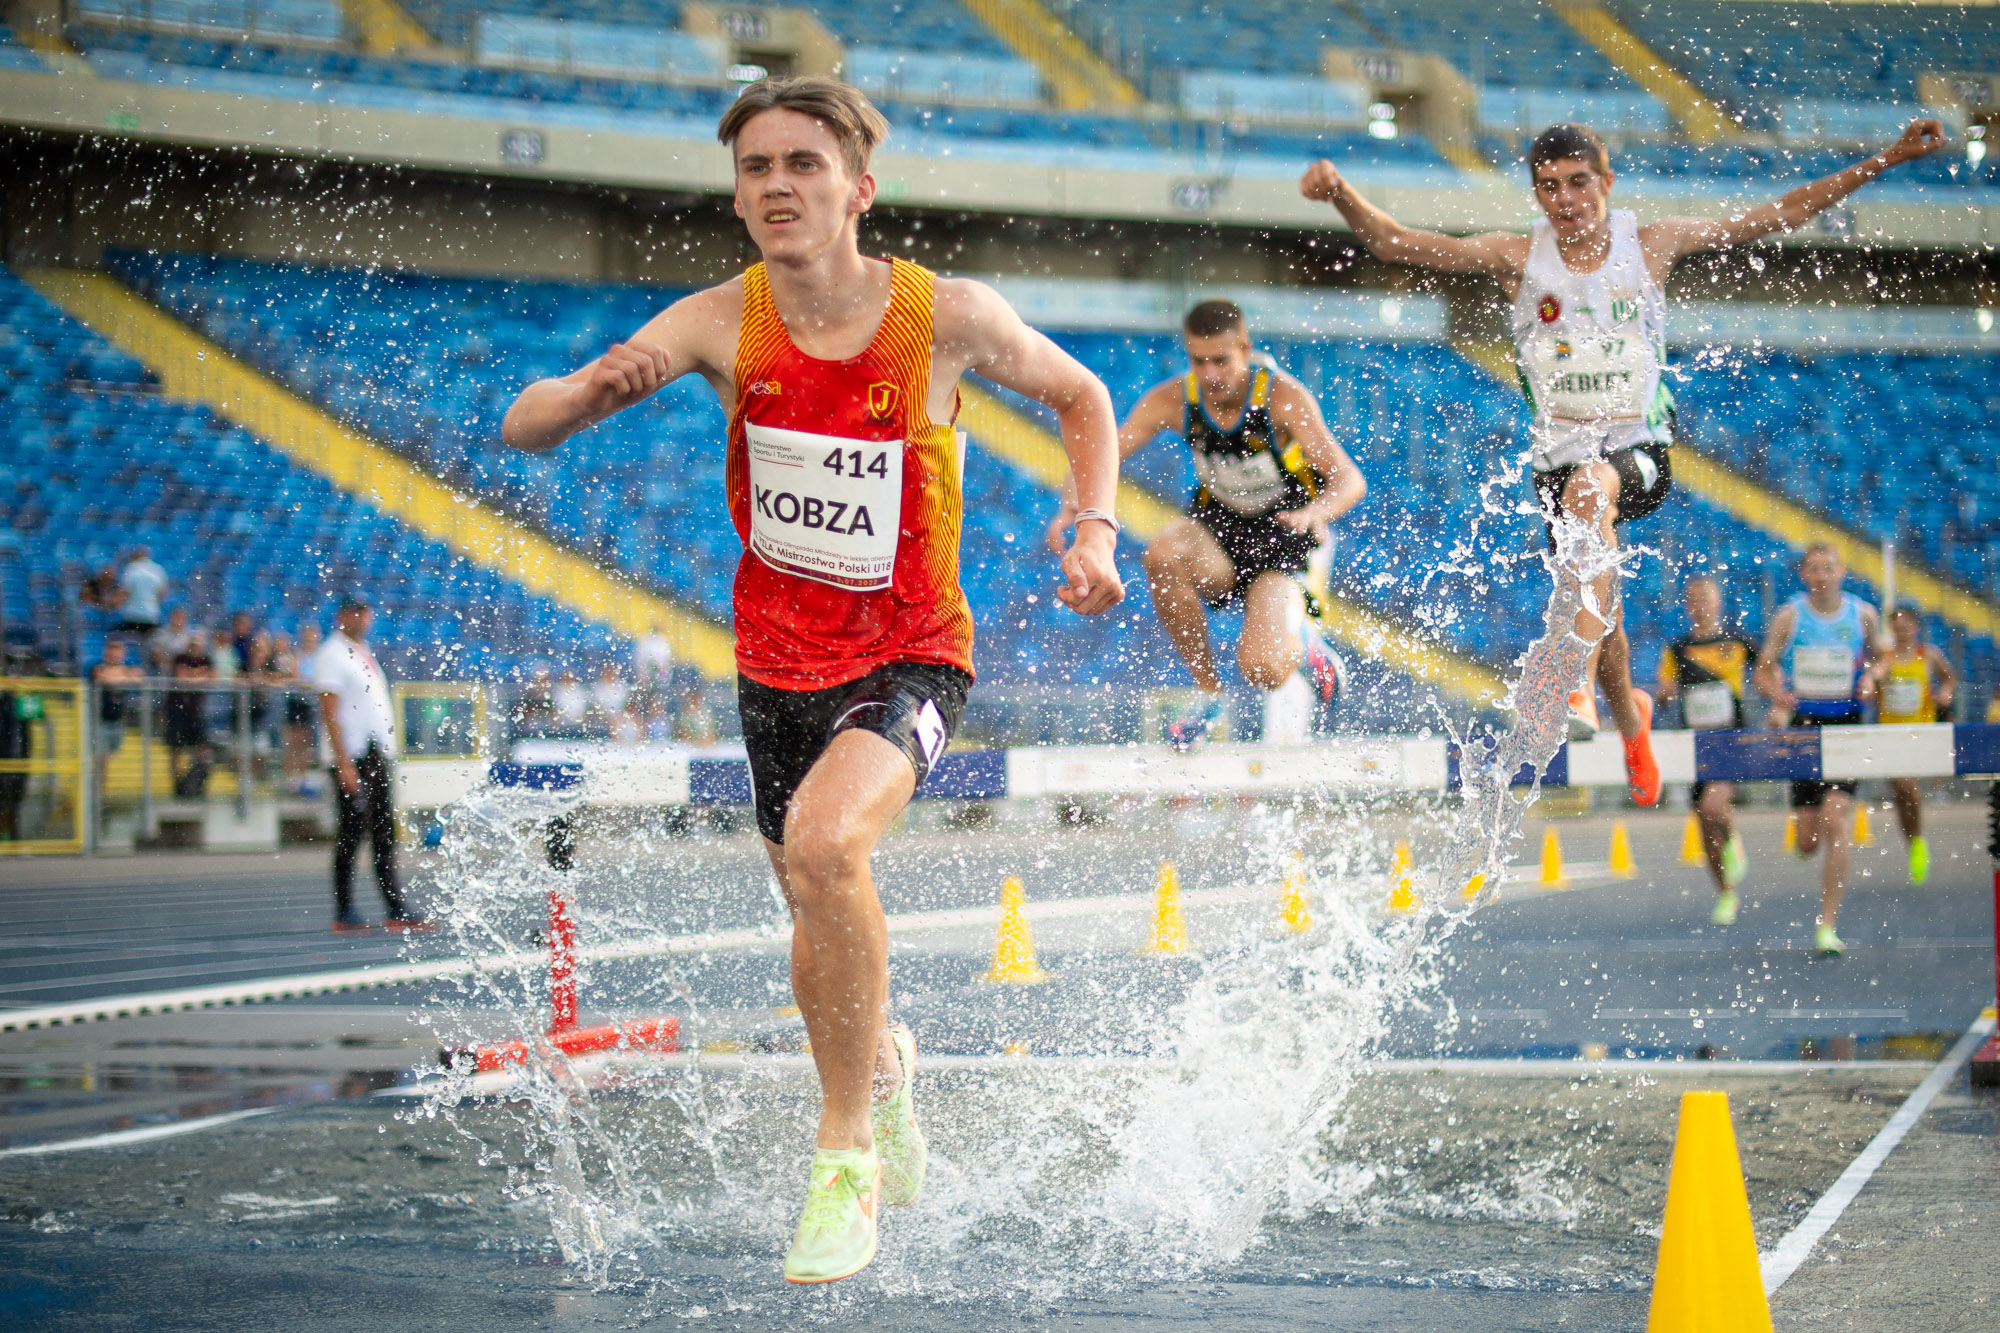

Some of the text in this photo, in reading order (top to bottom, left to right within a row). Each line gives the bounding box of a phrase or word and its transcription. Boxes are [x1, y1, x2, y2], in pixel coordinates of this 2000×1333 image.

[875, 389, 891, 411] J
[753, 439, 792, 452] Ministerstwo
[753, 446, 772, 458] Sportu
[777, 451, 805, 462] Turystyki
[823, 447, 889, 479] 414
[755, 483, 875, 536] KOBZA
[758, 536, 892, 574] PZLA Mistrzostwa Polski U18
[783, 541, 814, 554] Olimpiada
